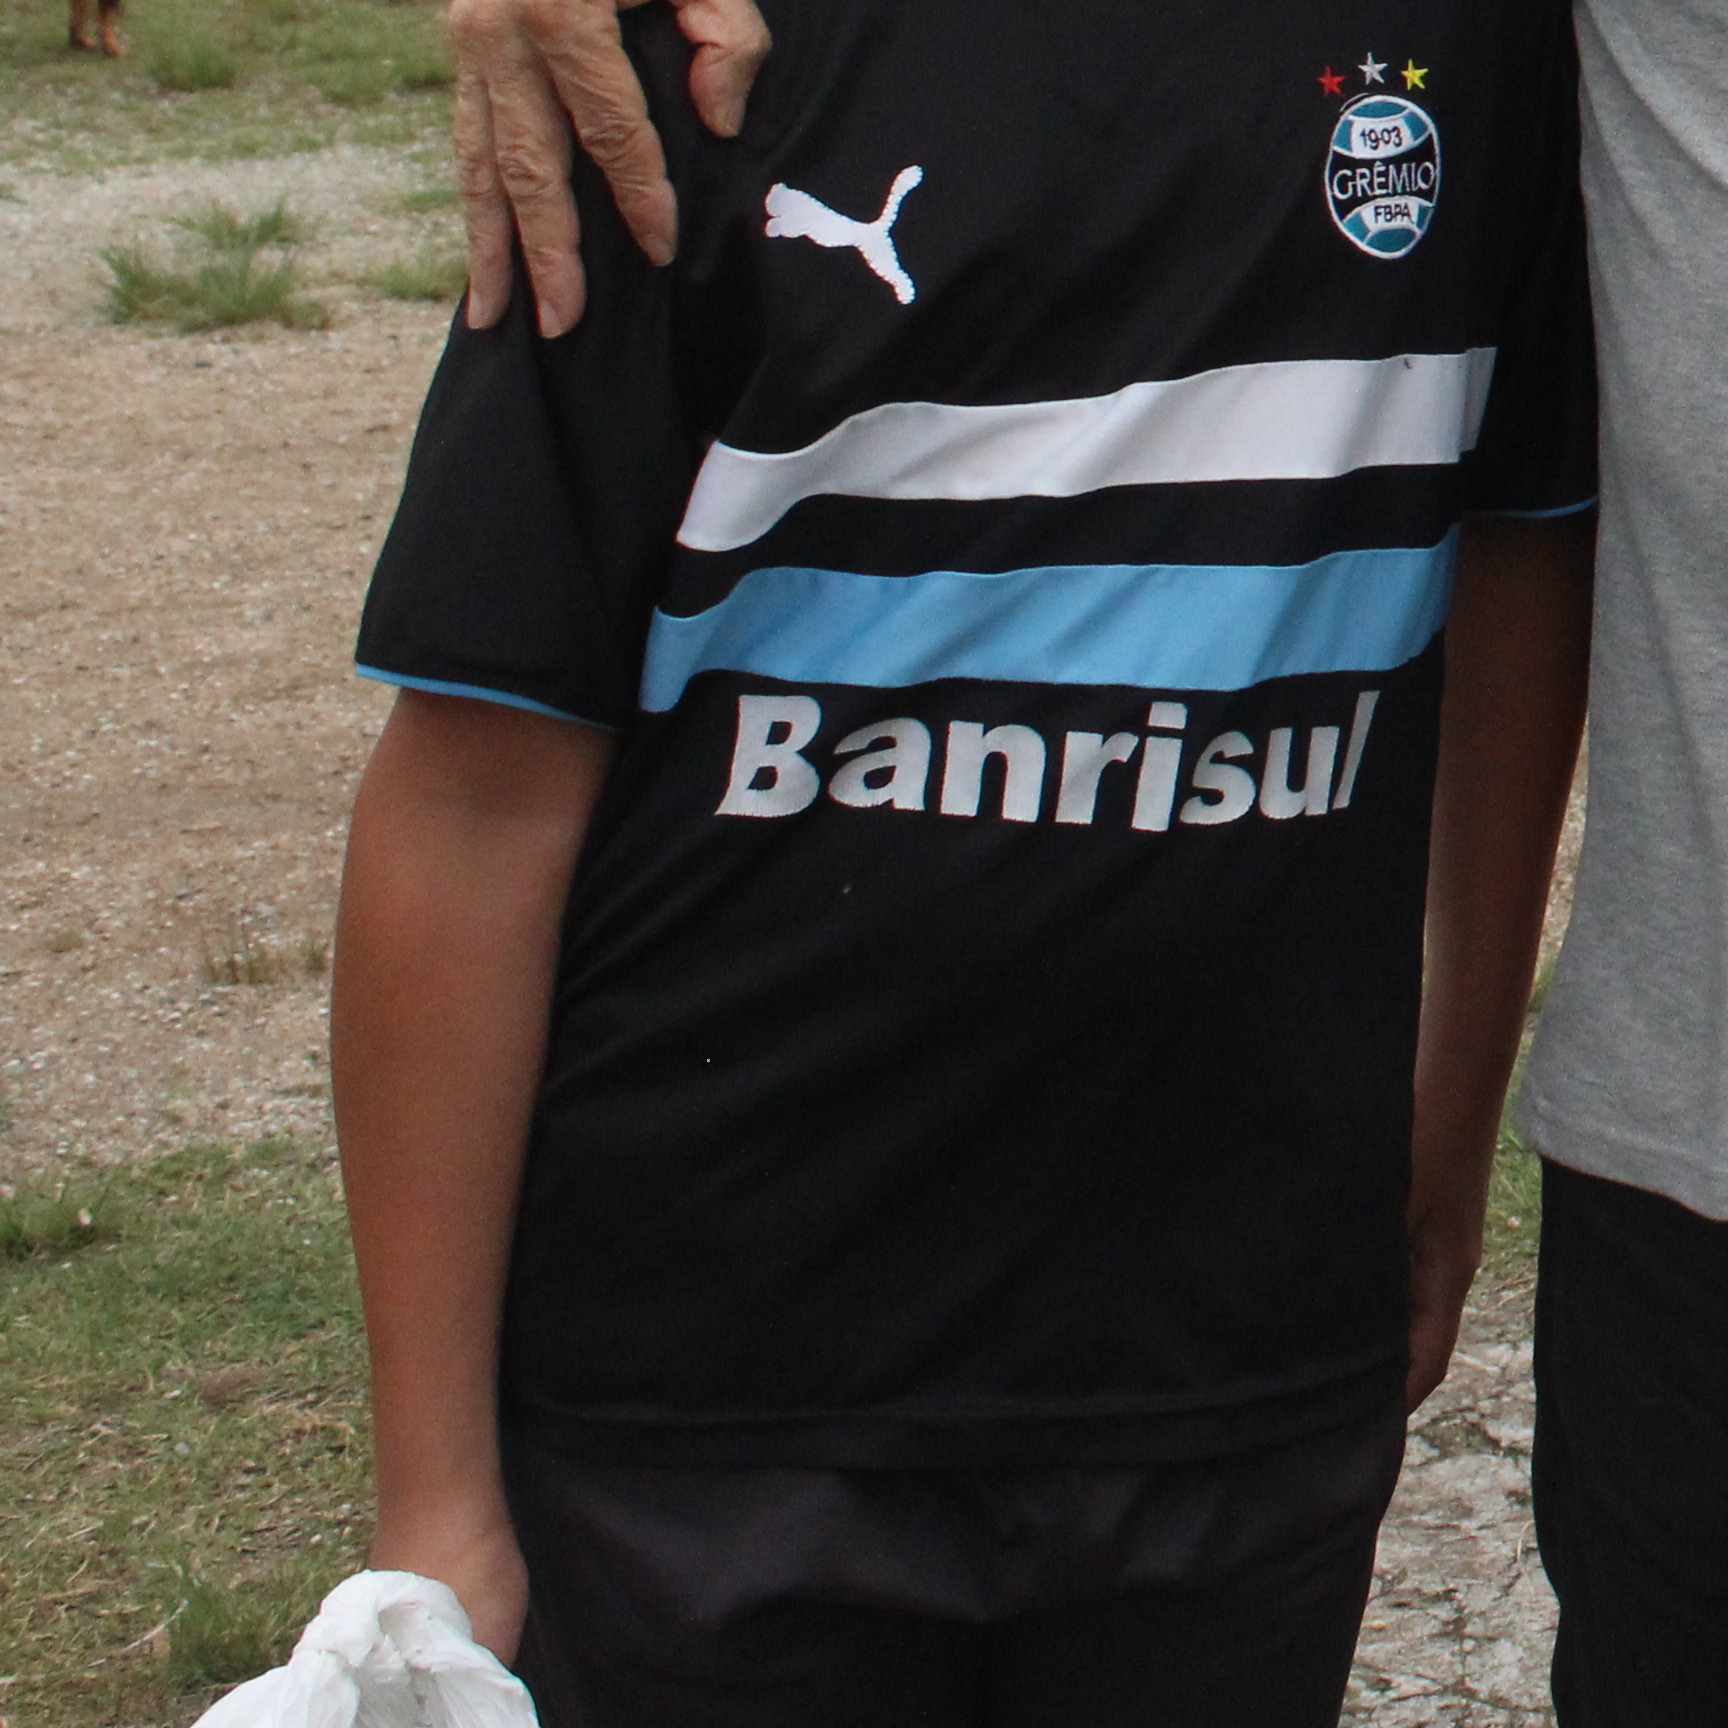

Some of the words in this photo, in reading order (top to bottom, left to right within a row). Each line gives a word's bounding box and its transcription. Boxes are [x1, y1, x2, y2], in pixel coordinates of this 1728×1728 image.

[1360, 126, 1402, 150] 1903
[1333, 161, 1436, 200] GRÊMIO
[1374, 202, 1416, 225] FBPA
[714, 689, 1381, 832] Banrisul
